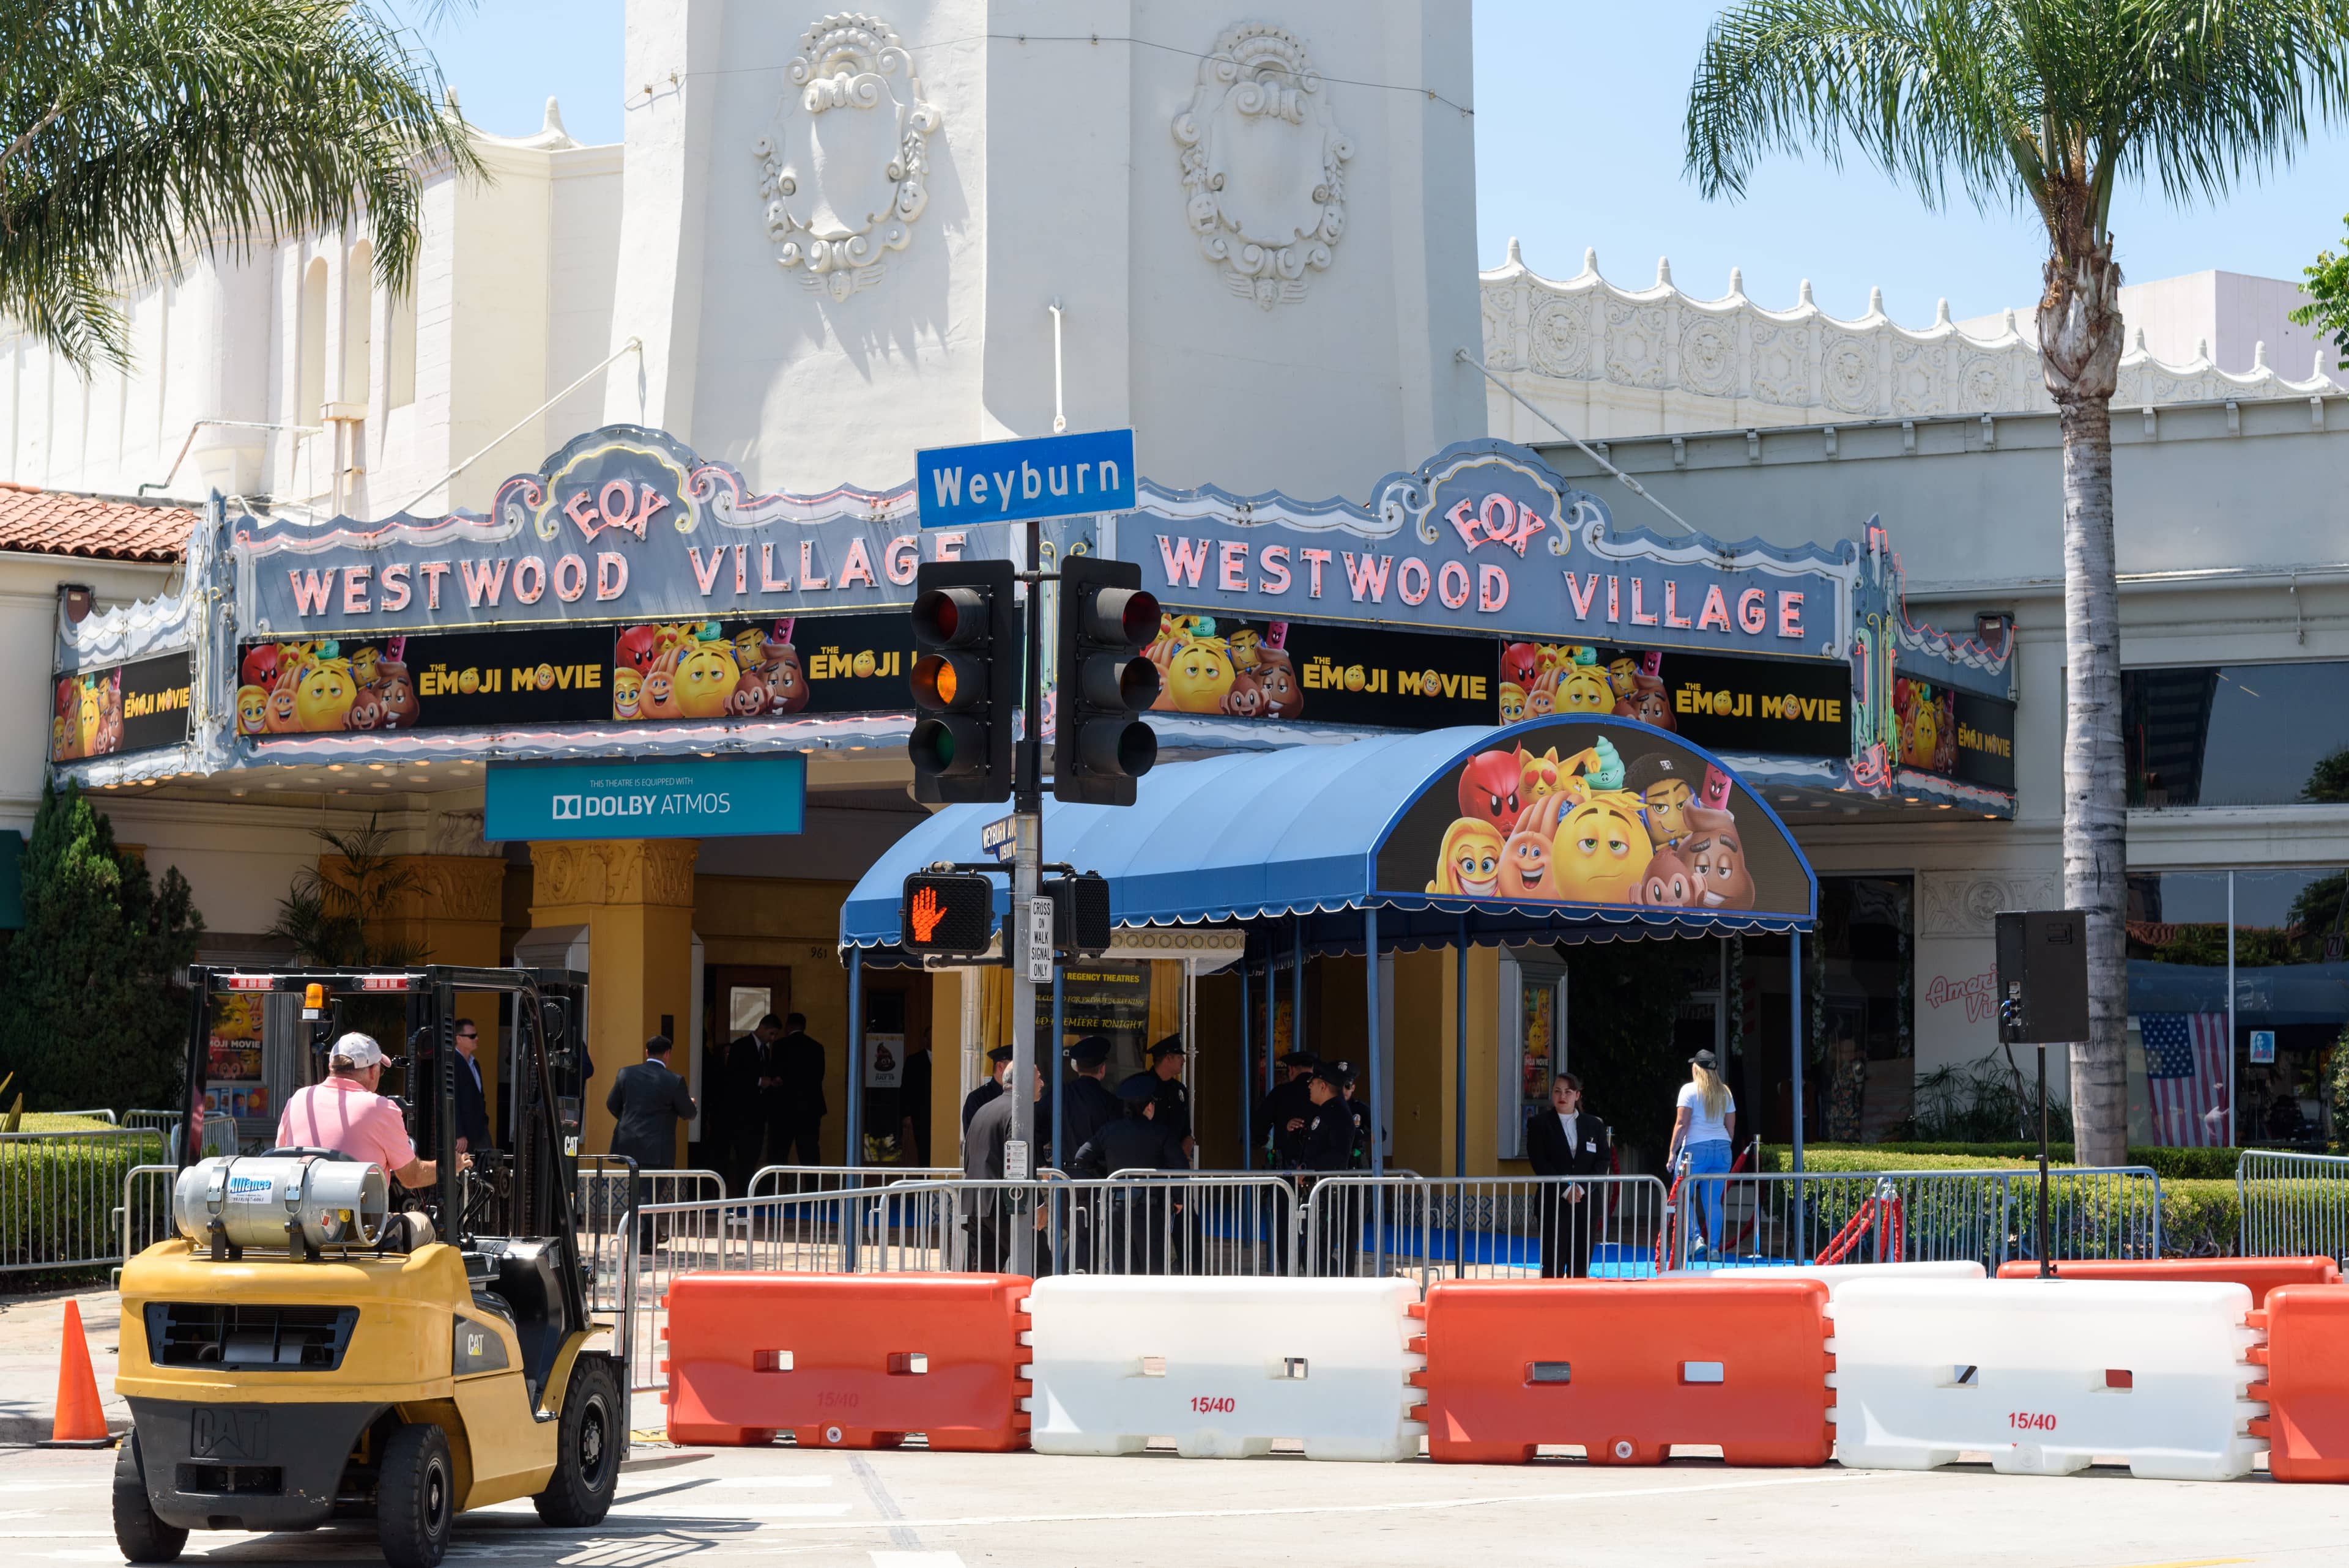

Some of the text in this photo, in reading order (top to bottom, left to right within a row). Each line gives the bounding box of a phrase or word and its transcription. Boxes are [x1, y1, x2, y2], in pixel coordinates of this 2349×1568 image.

[933, 459, 1120, 512] Weyburn
[563, 479, 671, 544] FOX
[1444, 492, 1546, 559] FOX
[289, 551, 629, 616] WESTWOOD
[1155, 533, 1805, 639] WESTWOOD VILLAGE
[820, 646, 839, 654] THE
[809, 649, 900, 679] EMOJI
[1313, 656, 1331, 665] THE
[420, 663, 602, 695] EMOJI MOVIE
[1303, 664, 1486, 700] EMOJI MOVIE
[1685, 682, 1701, 691] THE
[124, 687, 190, 719] EMOJI MOVIE
[1676, 690, 1841, 723] EMOJI MOVIE
[590, 780, 604, 788] THIS
[606, 778, 633, 788] THEATRE
[642, 777, 675, 786] EQUIPPED
[675, 777, 693, 785] WITH
[585, 793, 730, 816] DOLBY ATMOS
[982, 820, 1006, 849] WEYBURN
[1033, 901, 1051, 915] CROSS
[1038, 918, 1045, 928] ON
[1034, 931, 1048, 944] WALK
[811, 947, 828, 959] 961
[1031, 947, 1051, 961] SIGNAL
[1034, 963, 1048, 977] ONLY
[1067, 972, 1101, 982] REGENCY
[1102, 974, 1140, 983] THEATRES
[1110, 997, 1145, 1008] SCREENING
[1101, 1019, 1144, 1030] TONIGHT
[231, 1040, 261, 1049] MOVIE
[564, 1135, 579, 1156] CAT
[230, 1177, 272, 1193] Alliance
[468, 1334, 484, 1356] CAT
[817, 1391, 859, 1408] 15/40
[1190, 1397, 1236, 1414] 15/40
[2008, 1411, 2057, 1432] 15/40
[190, 1408, 270, 1460] CAT
